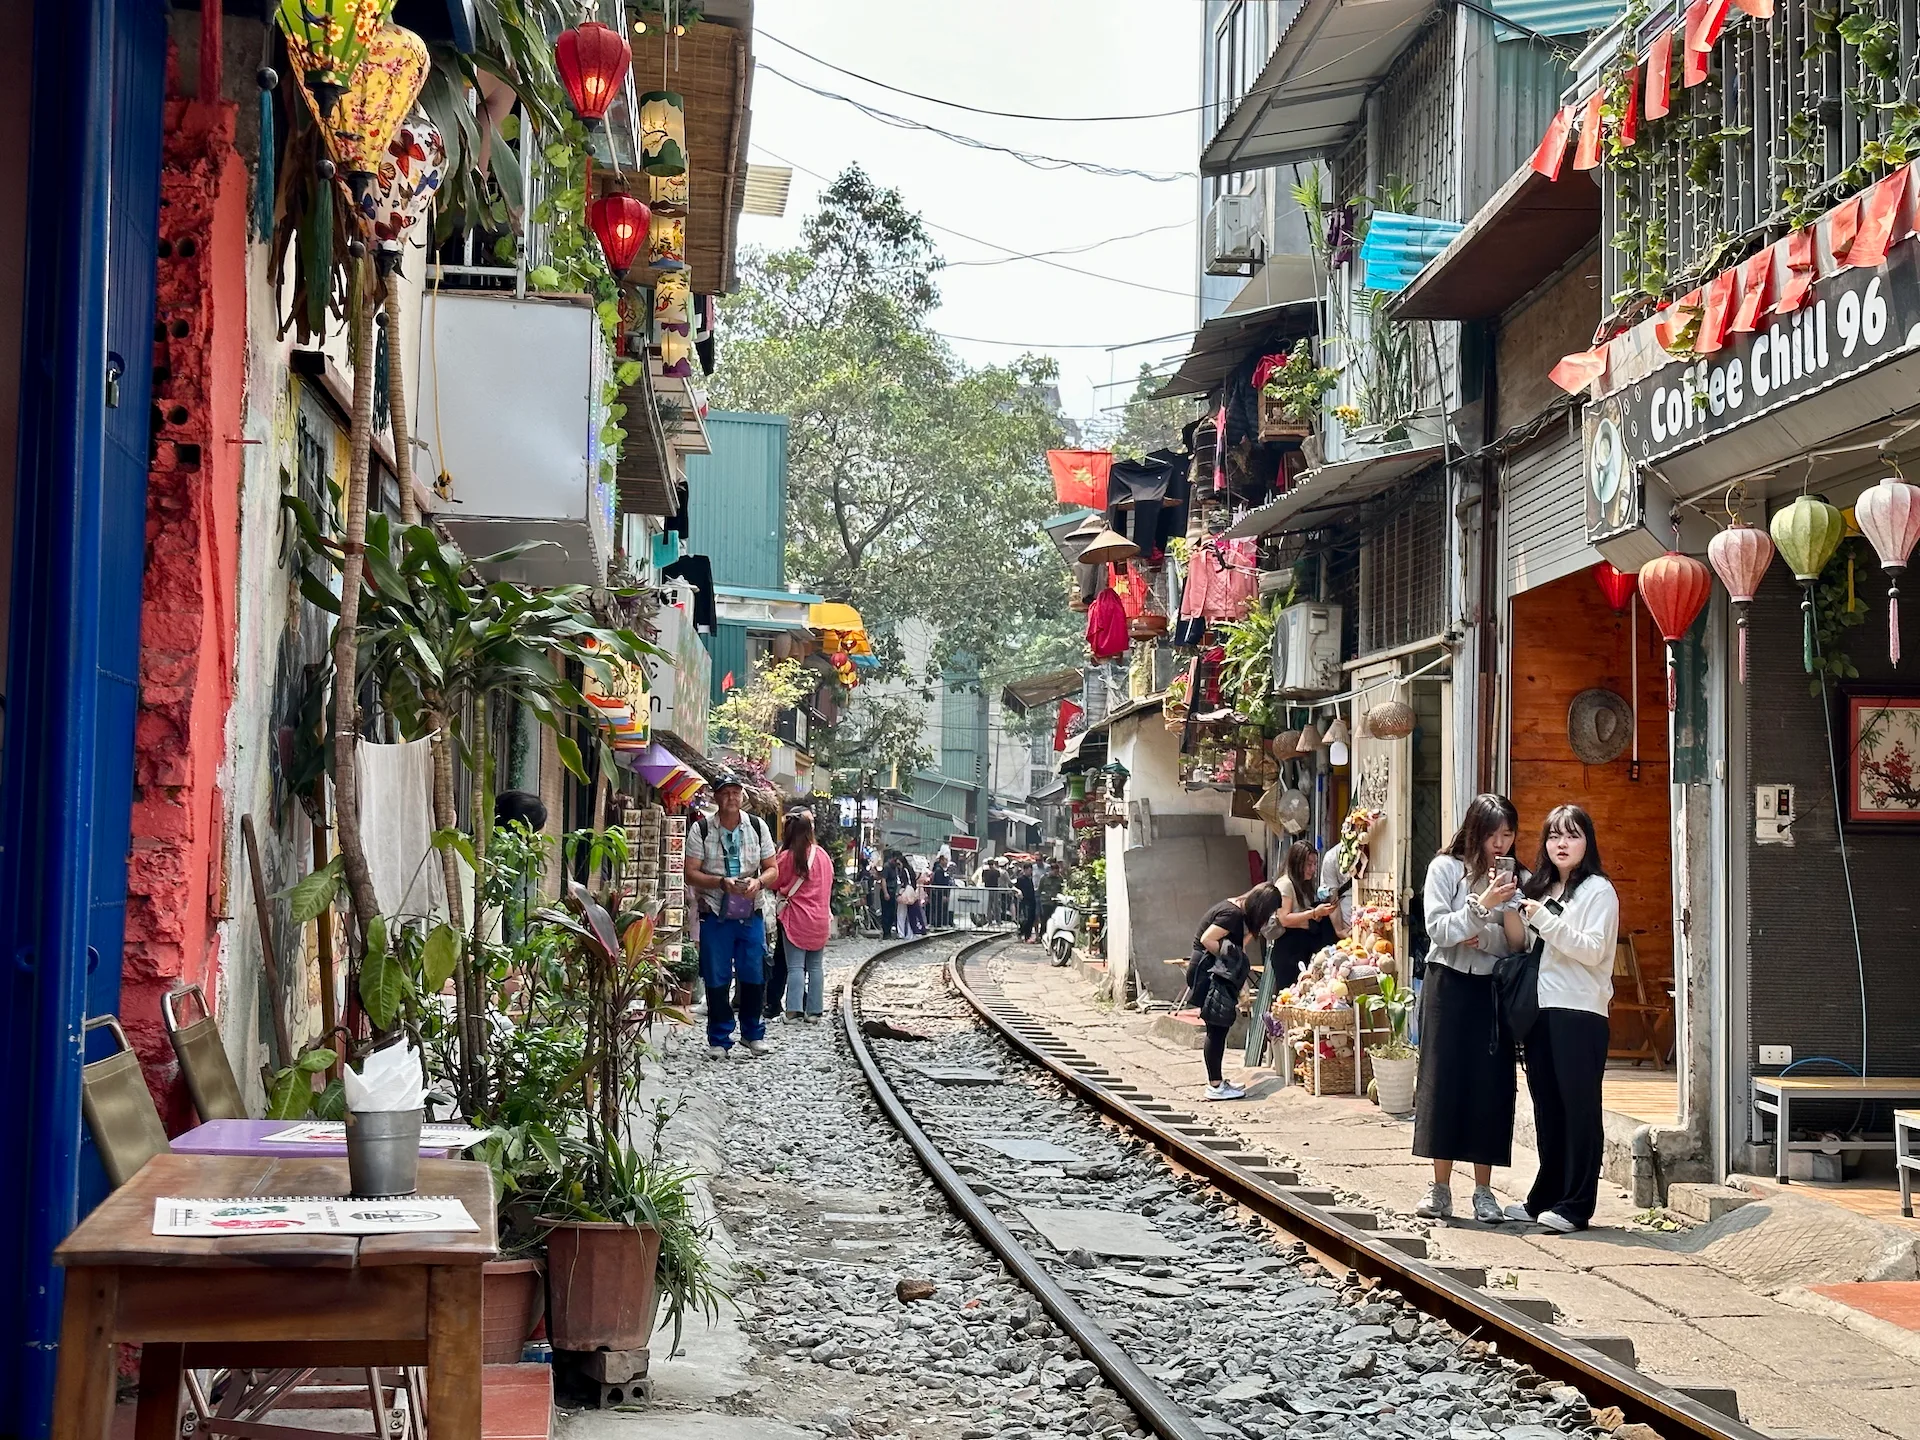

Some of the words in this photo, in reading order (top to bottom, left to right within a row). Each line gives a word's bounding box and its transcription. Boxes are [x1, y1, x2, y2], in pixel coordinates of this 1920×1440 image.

[1650, 358, 1743, 443] Coffee
[1751, 299, 1829, 397] Chill
[1836, 276, 1887, 358] 96
